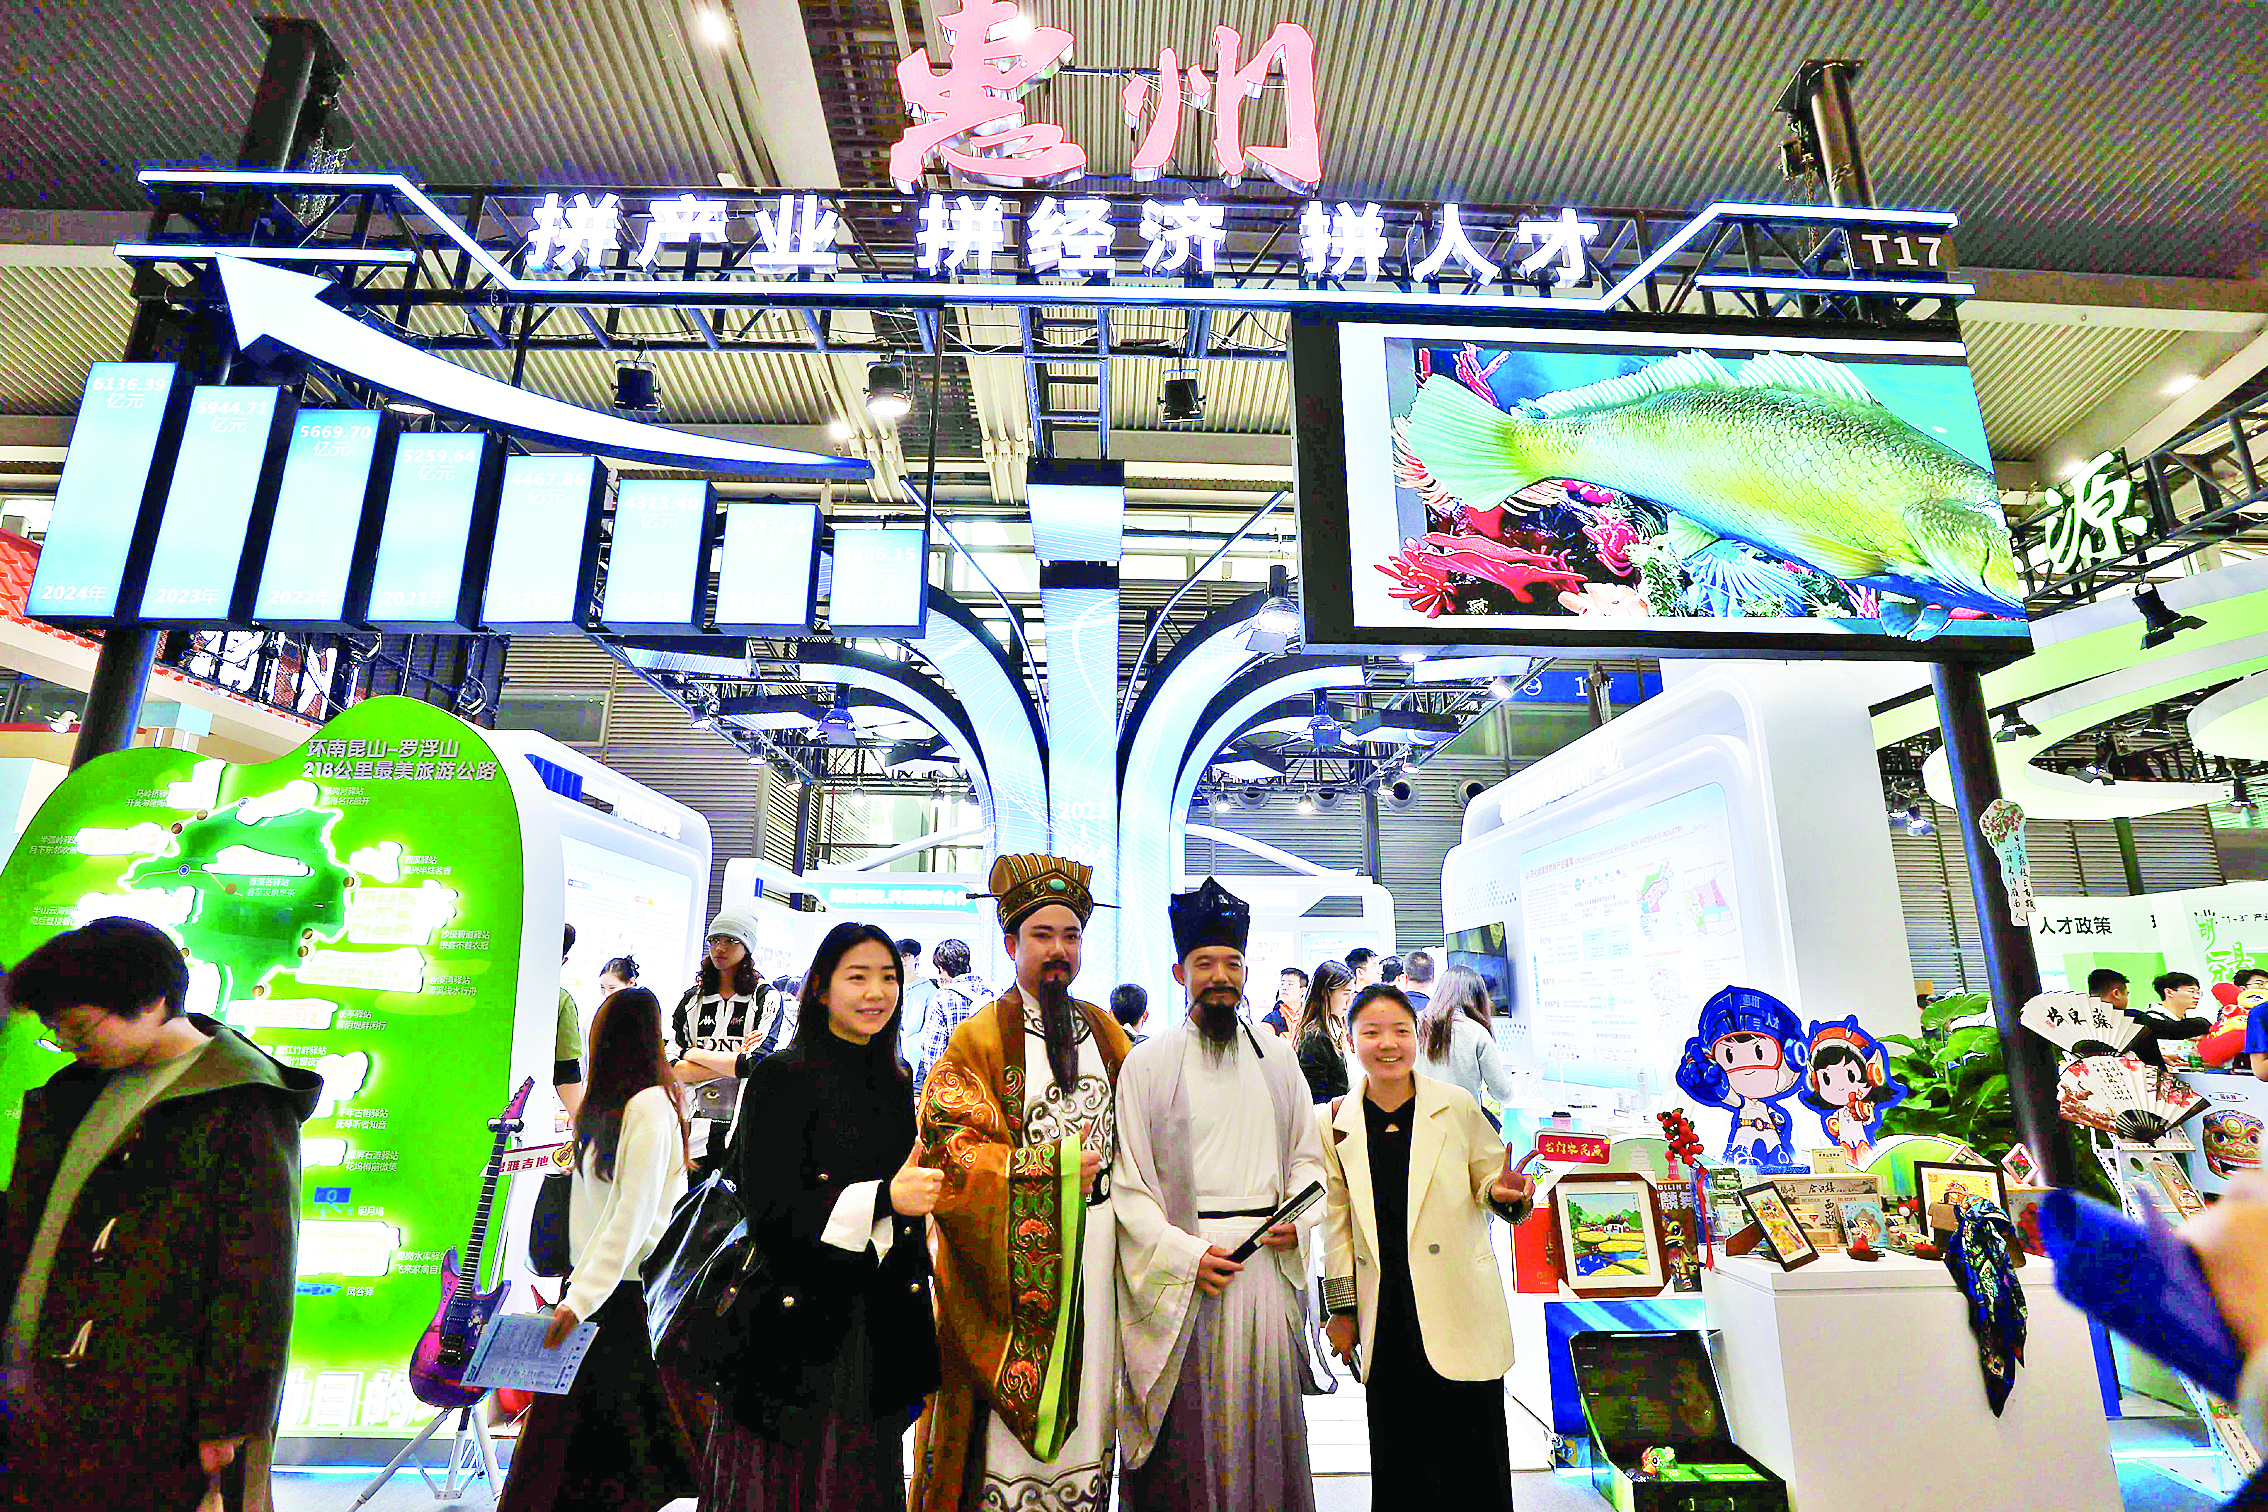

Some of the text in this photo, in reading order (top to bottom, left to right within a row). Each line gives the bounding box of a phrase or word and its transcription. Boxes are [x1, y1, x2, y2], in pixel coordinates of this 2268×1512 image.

[889, 0, 1322, 190] 惠州
[528, 192, 1600, 287] 拼产业 拼经济 拼人才
[1861, 233, 1942, 266] T17
[92, 377, 167, 392] 6136.39
[106, 391, 144, 409] 亿元
[196, 401, 268, 416] 5944.71
[209, 415, 248, 433] 亿元
[299, 424, 372, 440] 5669.70
[312, 439, 351, 458] 亿元
[402, 448, 476, 463] 5259.64
[416, 463, 456, 482] 亿元
[511, 472, 586, 487] 4467.86
[526, 487, 565, 505] 亿元
[2044, 450, 2148, 573] 源
[41, 584, 107, 602] 2024年
[155, 587, 220, 605] 2023年
[268, 589, 333, 607] 2022年
[380, 590, 447, 608] 2021年
[302, 760, 498, 782] 218公里最美旅游公路
[2039, 916, 2113, 936] 人才政策
